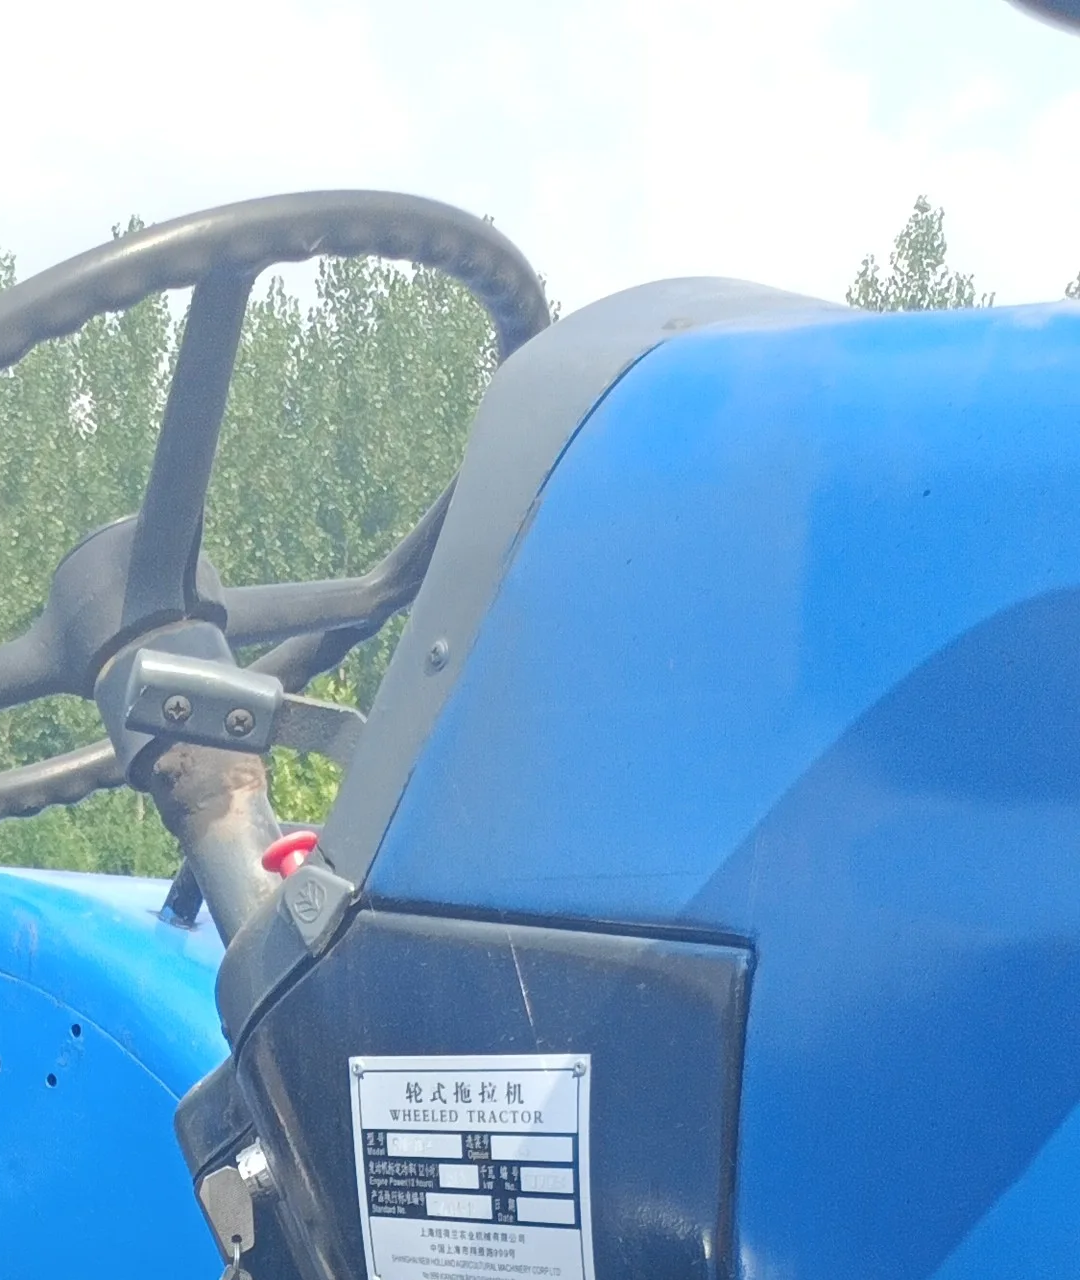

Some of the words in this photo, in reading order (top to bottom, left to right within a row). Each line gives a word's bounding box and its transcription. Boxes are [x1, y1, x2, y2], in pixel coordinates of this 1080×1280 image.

[406, 1081, 524, 1104] 轮式拖拉机
[389, 1109, 458, 1122] WHEELED
[467, 1110, 544, 1124] TRACTOR
